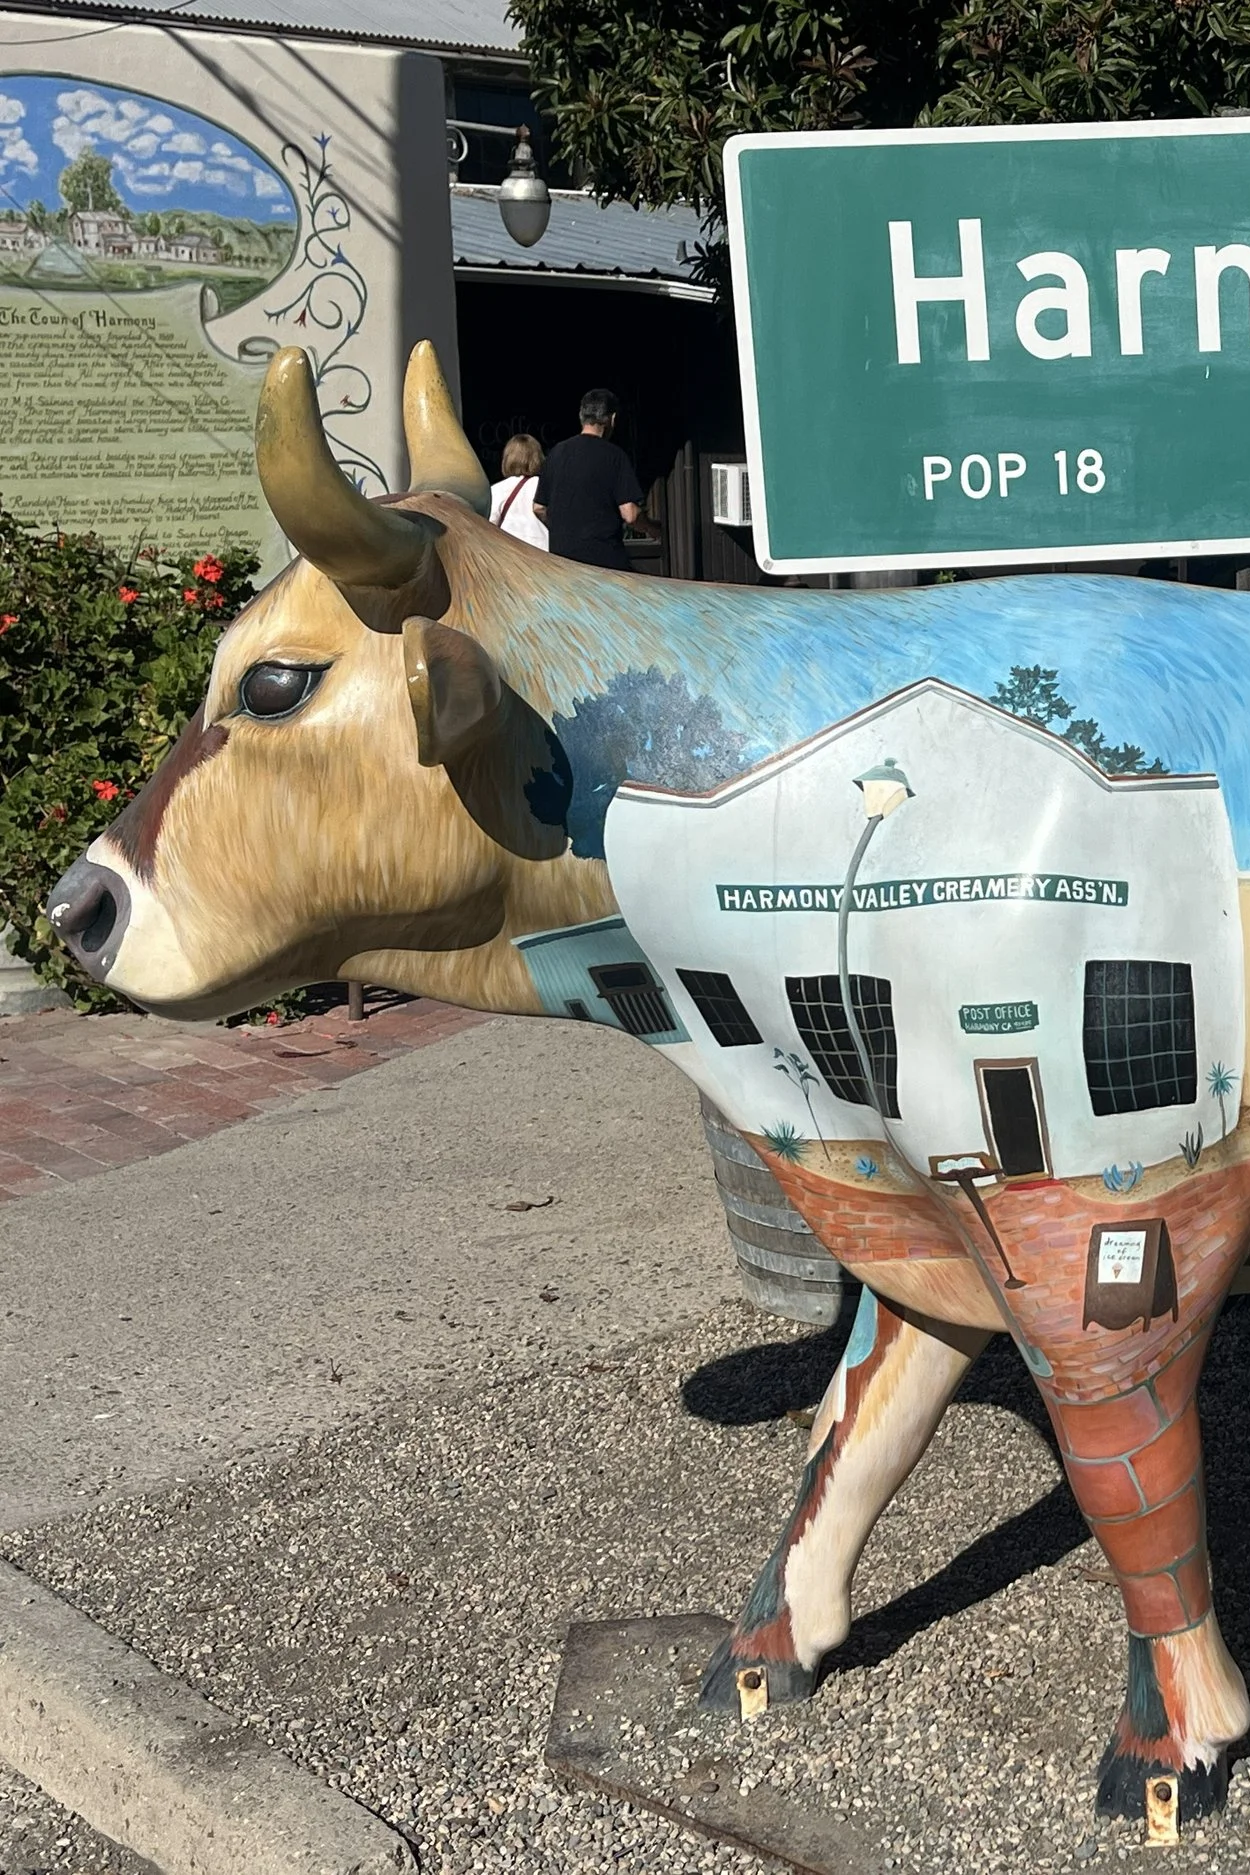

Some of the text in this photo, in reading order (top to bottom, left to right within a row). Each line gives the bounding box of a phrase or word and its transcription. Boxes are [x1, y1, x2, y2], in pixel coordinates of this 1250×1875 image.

[0, 306, 156, 331] The Town of Harmony
[83, 405, 126, 418] Harmony
[922, 449, 1106, 500] POP 18
[177, 528, 197, 539] San
[723, 877, 1123, 909] HARMONY VALLEY CREAMERY ASS'N.
[962, 1003, 1032, 1021] POST OFFICE
[965, 1022, 1000, 1032] HARMONY
[1001, 1022, 1012, 1031] CA
